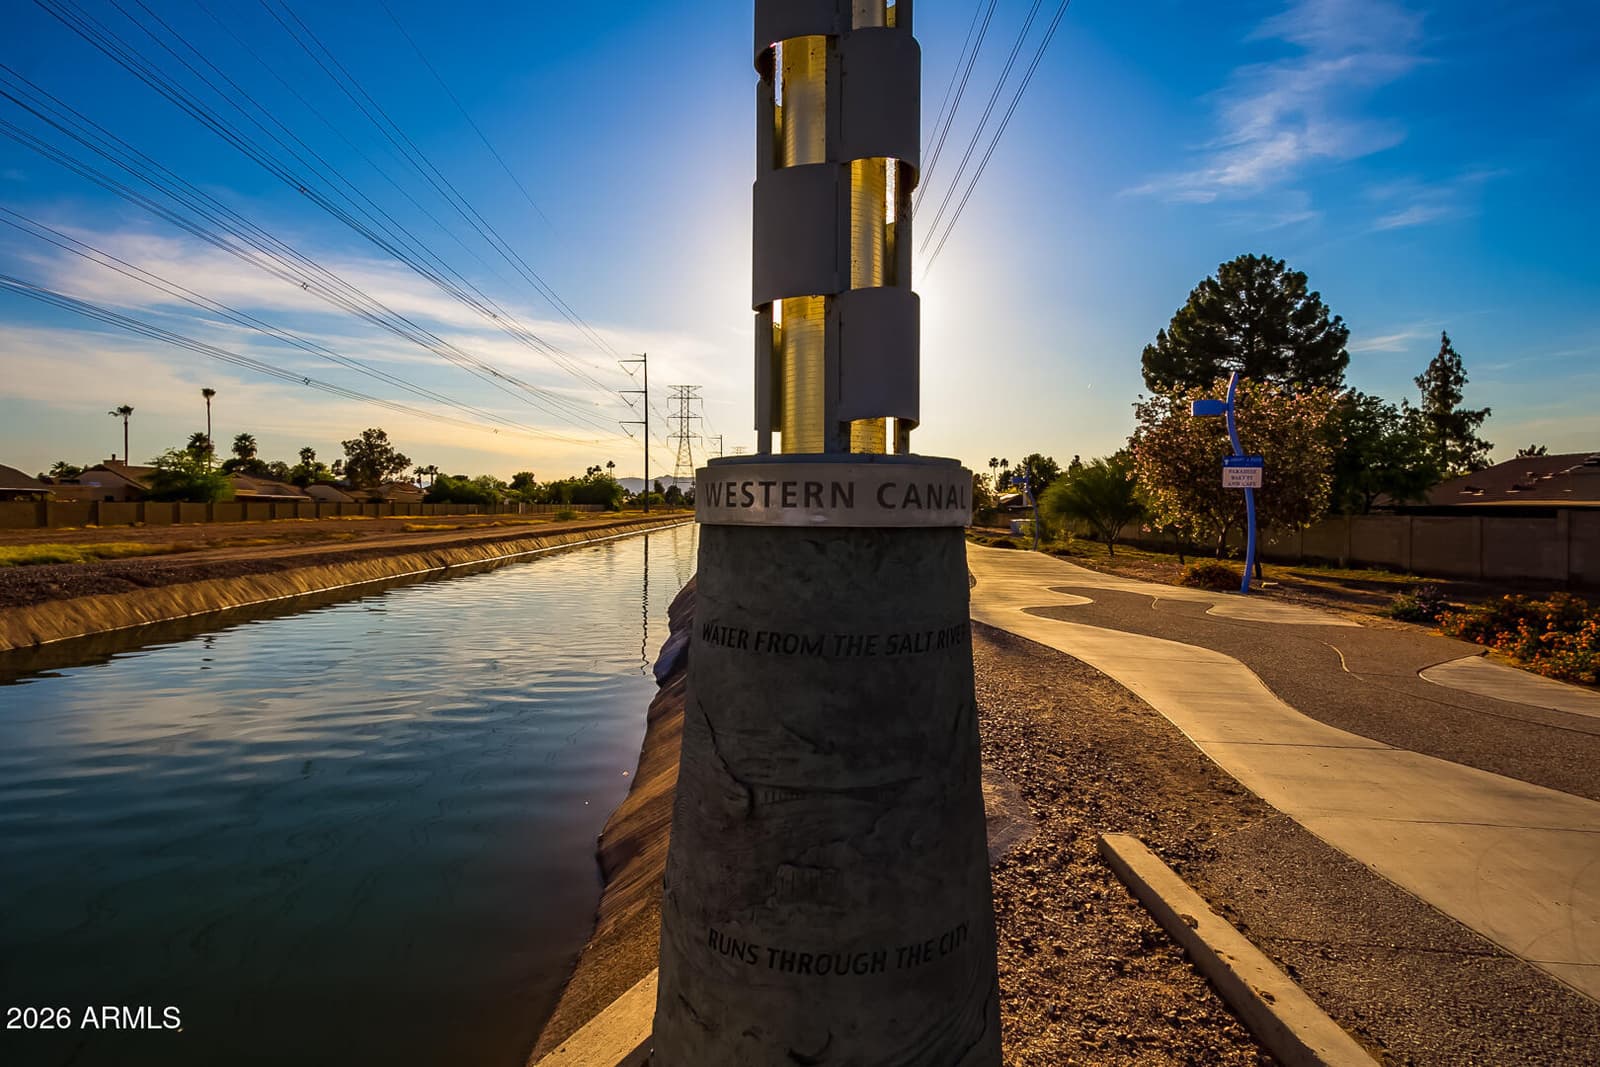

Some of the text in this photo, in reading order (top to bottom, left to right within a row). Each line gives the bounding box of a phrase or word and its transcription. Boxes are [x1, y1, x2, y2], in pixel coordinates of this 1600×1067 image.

[705, 481, 966, 509] WESTERN CANAL
[702, 623, 749, 650] WATER
[754, 631, 825, 657] FROM
[833, 634, 880, 656] THE
[885, 631, 934, 656] SALT
[708, 920, 970, 976] RUNS THROUGH THE CITY
